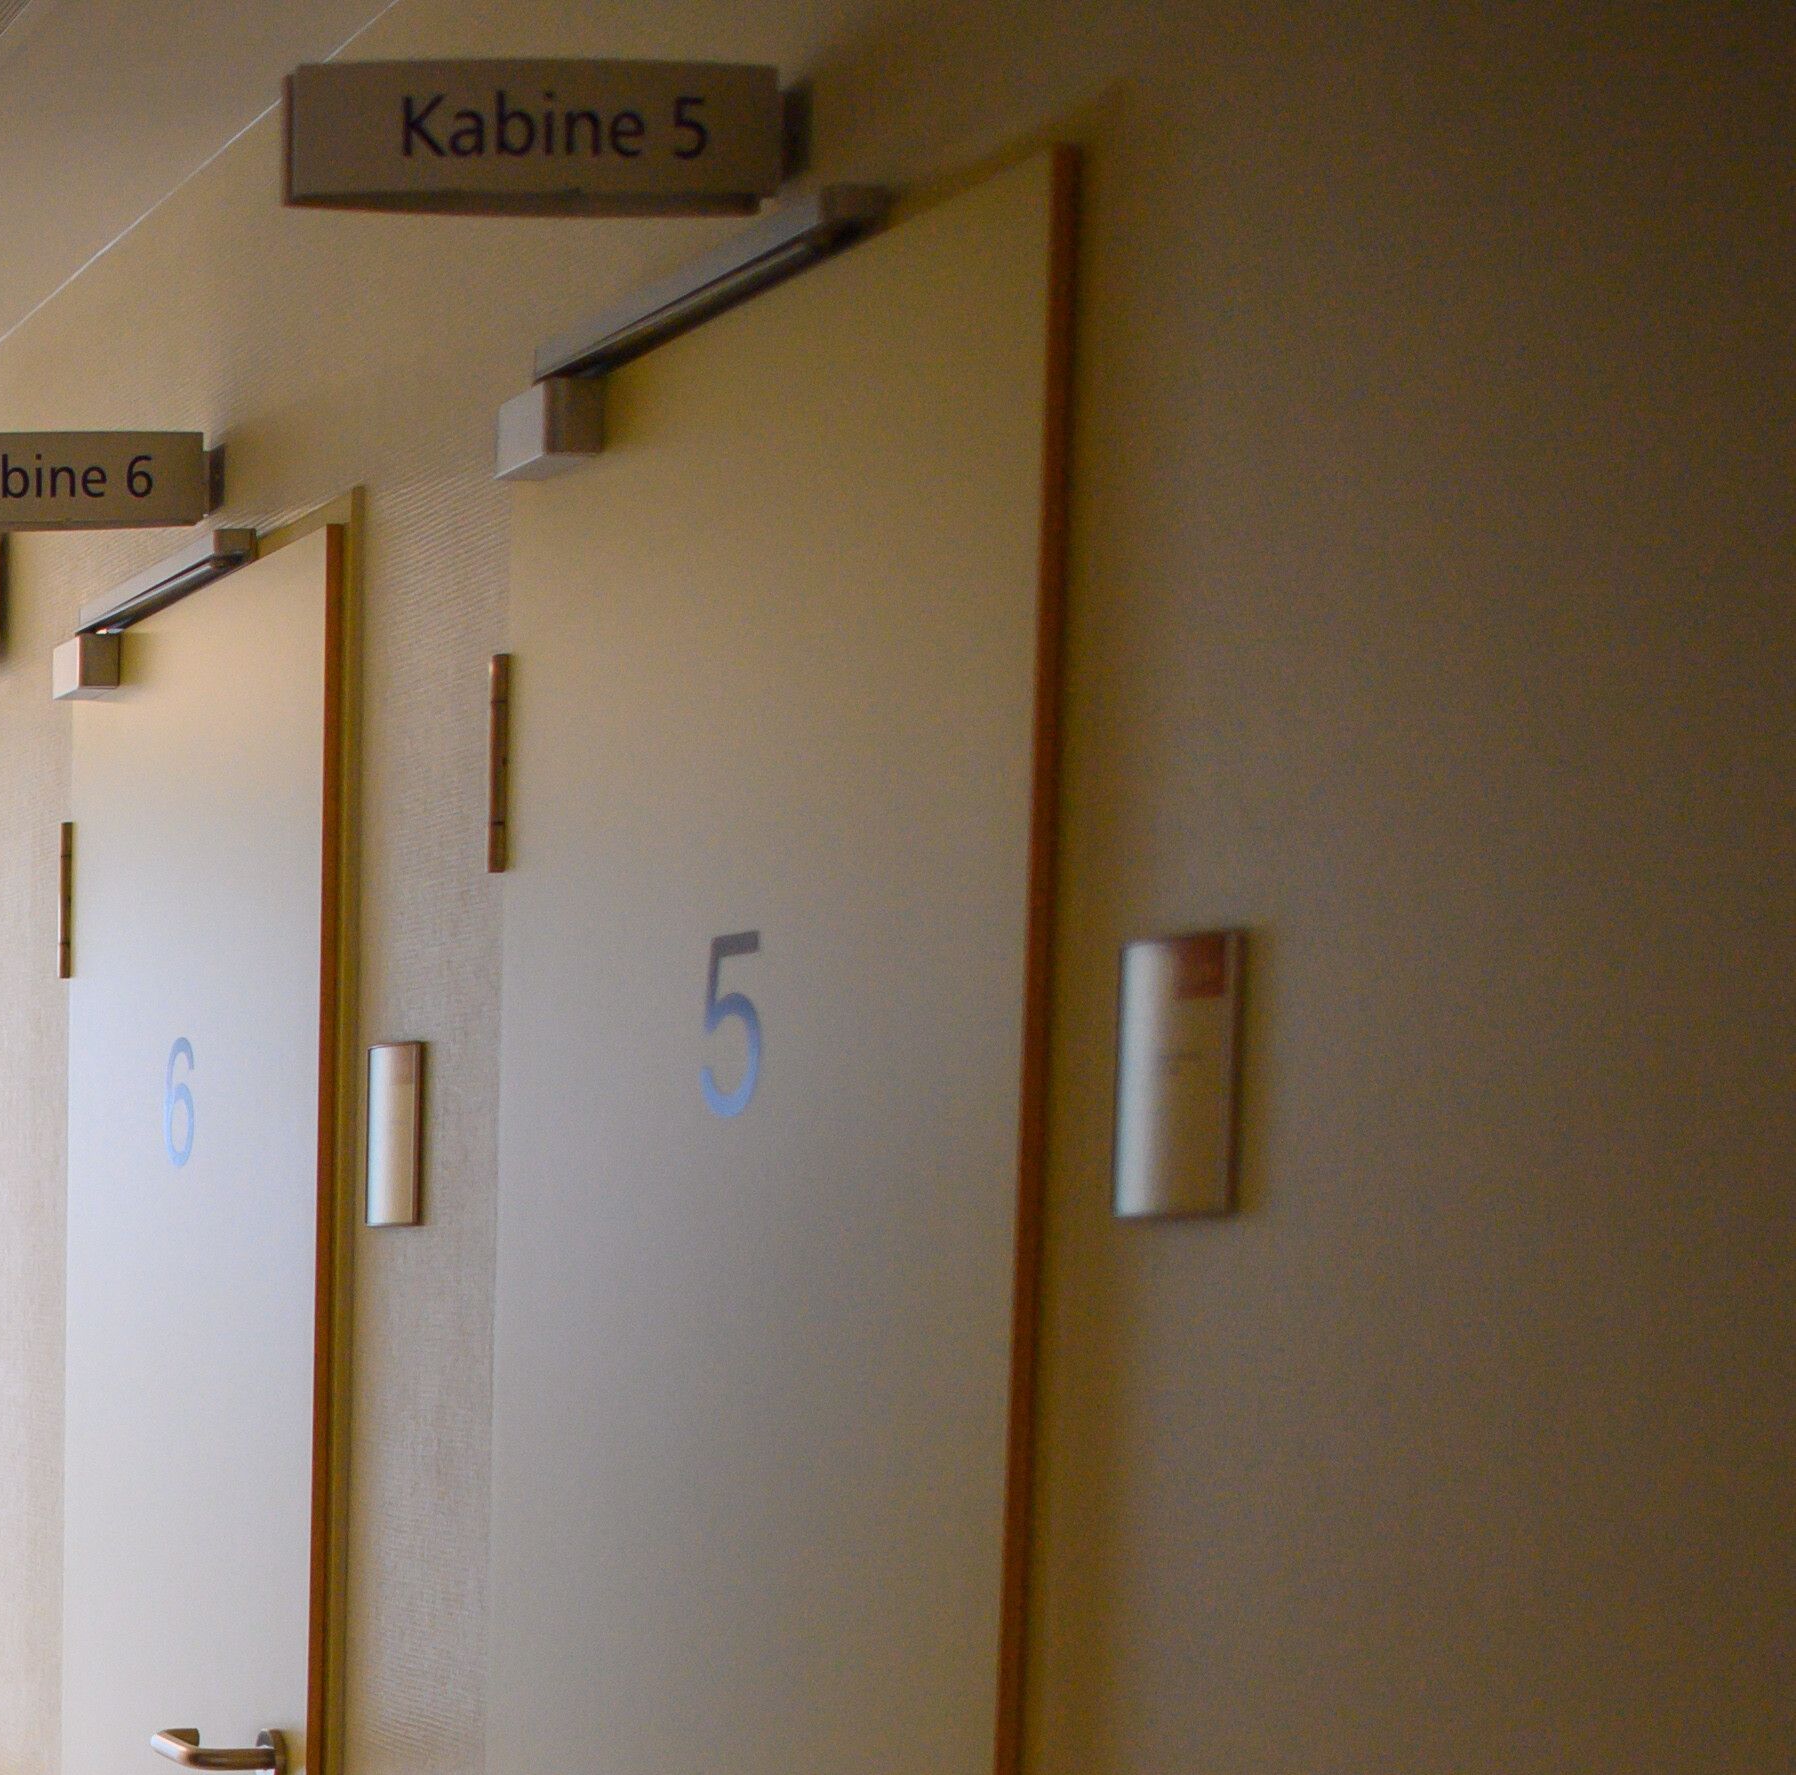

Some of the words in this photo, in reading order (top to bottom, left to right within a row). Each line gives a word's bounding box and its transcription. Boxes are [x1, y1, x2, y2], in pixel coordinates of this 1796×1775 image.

[401, 90, 646, 160] Kabine
[672, 96, 711, 160] 5
[125, 454, 154, 500] 6
[699, 929, 761, 1118] 5
[164, 1036, 195, 1169] 6
